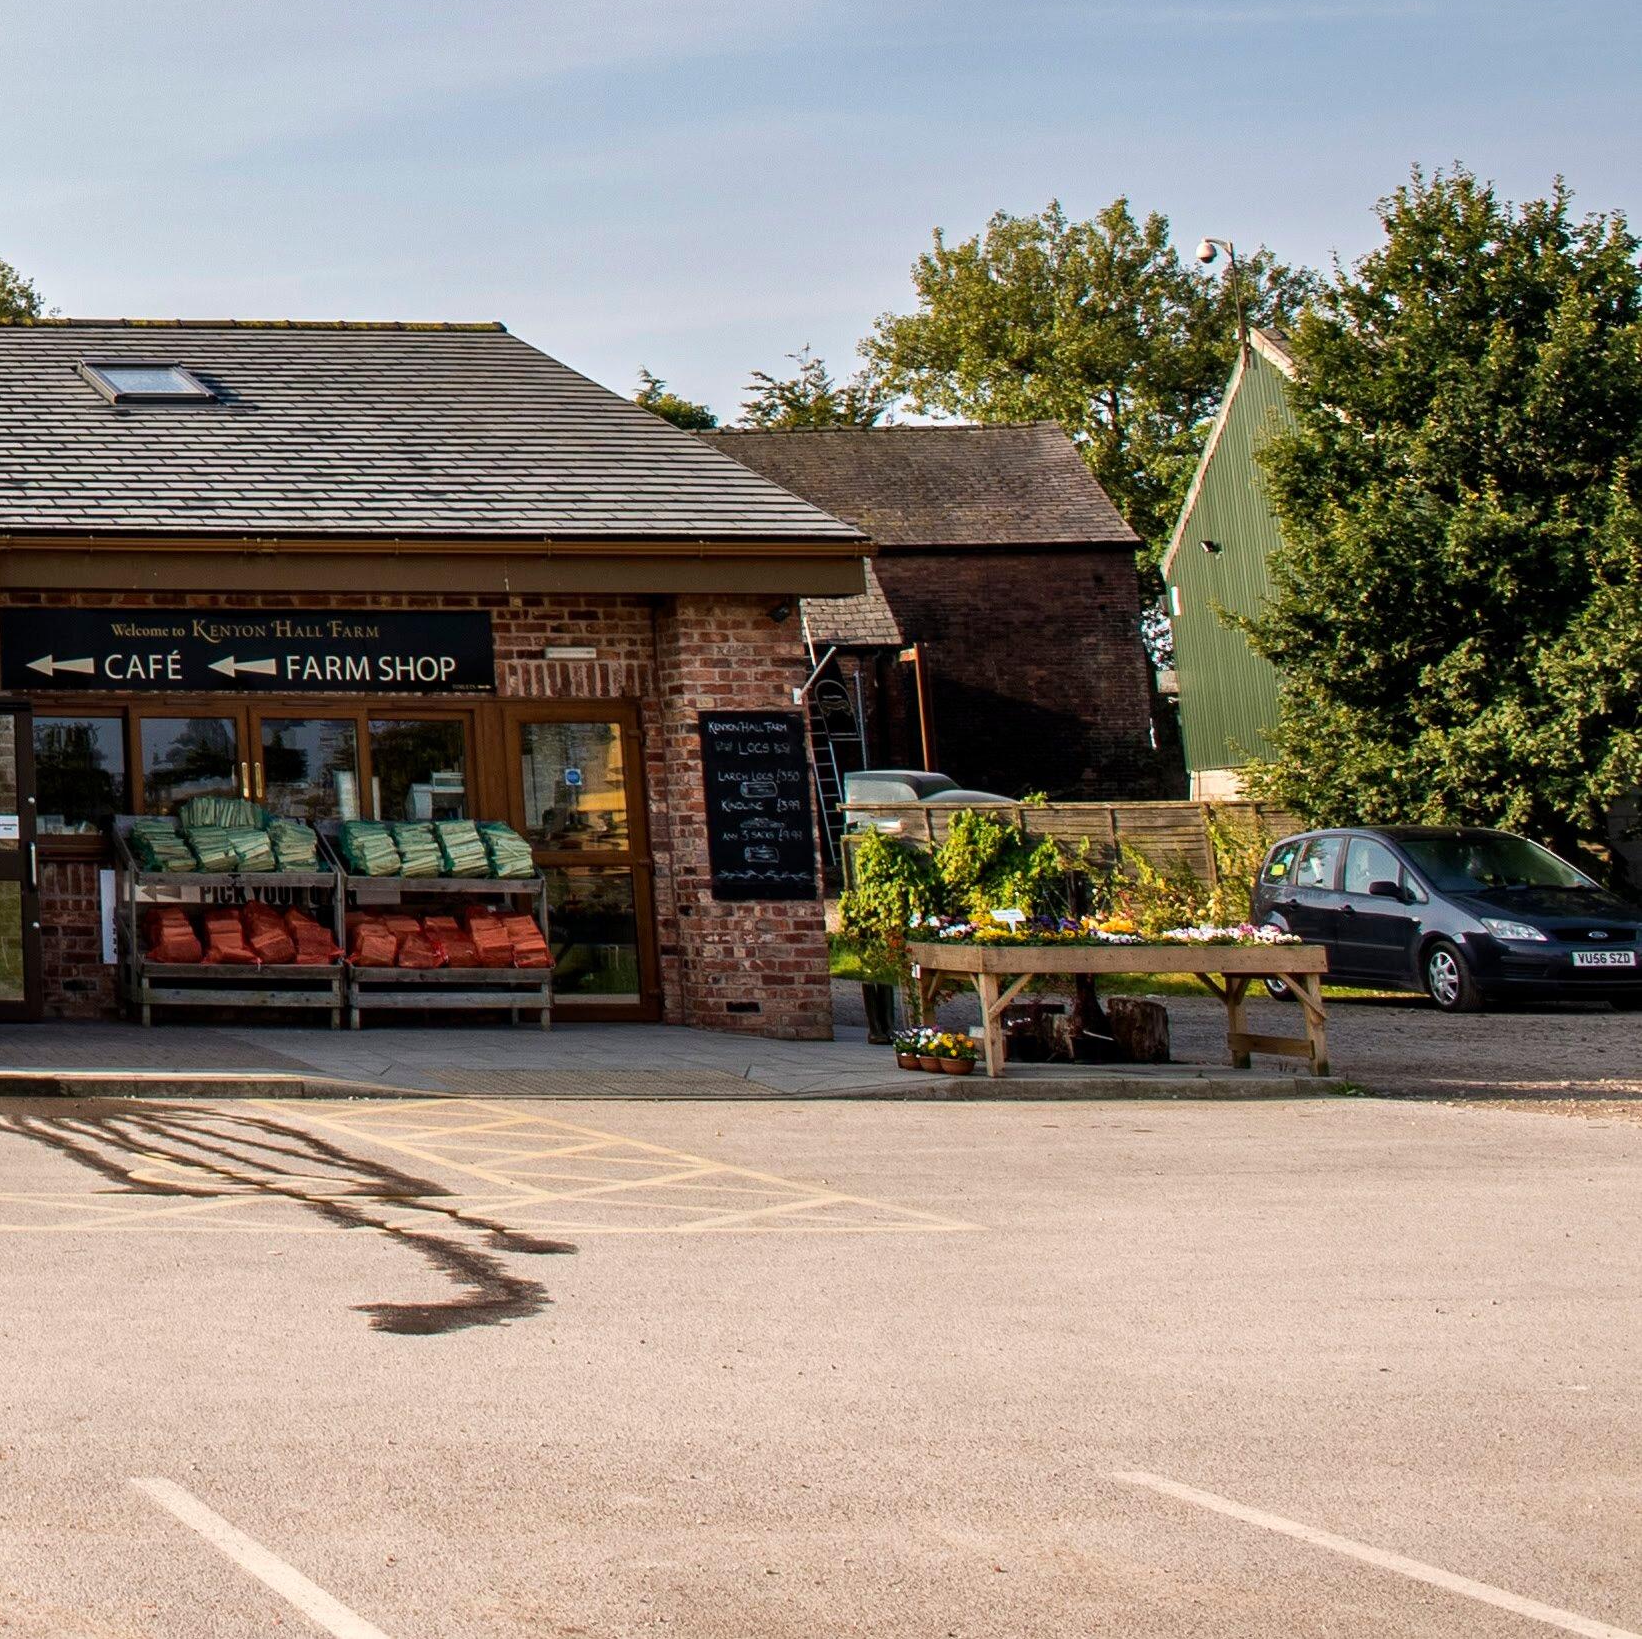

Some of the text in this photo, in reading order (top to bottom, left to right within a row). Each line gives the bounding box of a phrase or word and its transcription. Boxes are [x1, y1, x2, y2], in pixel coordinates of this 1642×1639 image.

[111, 619, 380, 643] Welcome to KENYON HALL FARM
[104, 650, 456, 681] CAFÉ FARM SHOP
[1578, 953, 1607, 964] VU56
